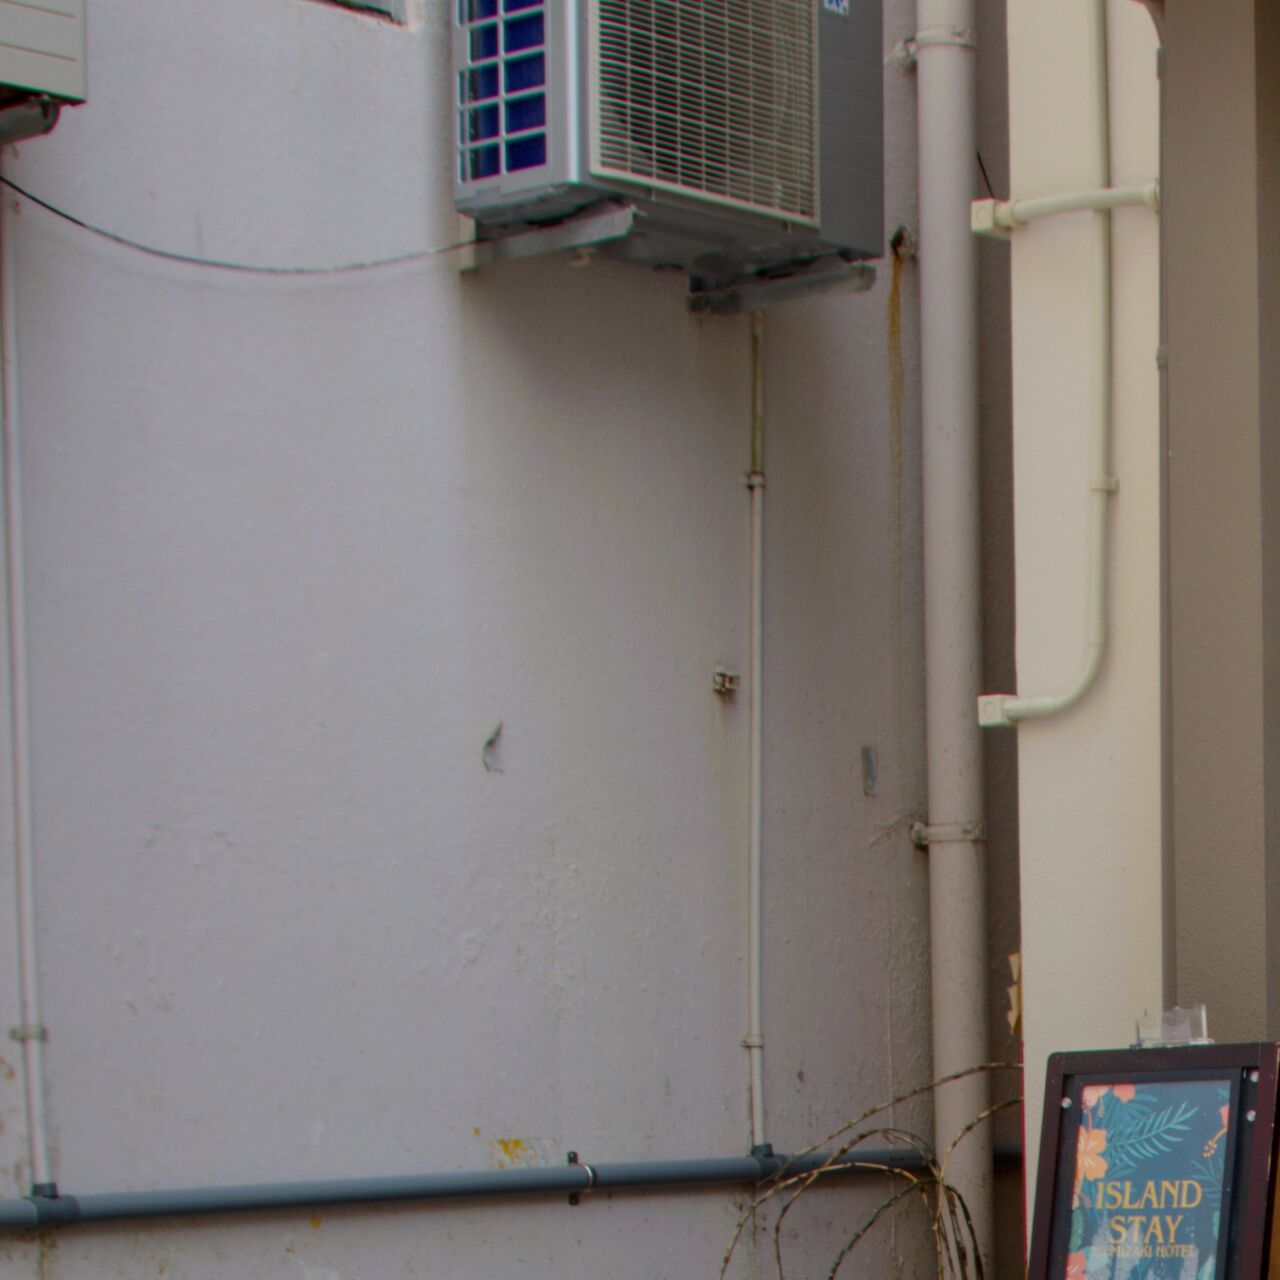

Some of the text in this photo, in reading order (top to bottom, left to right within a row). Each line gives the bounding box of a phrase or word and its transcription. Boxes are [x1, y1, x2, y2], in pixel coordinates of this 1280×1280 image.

[1096, 1179, 1203, 1210] ISLAND
[1109, 1214, 1184, 1245] STAY
[1156, 1244, 1196, 1258] HOTEL
